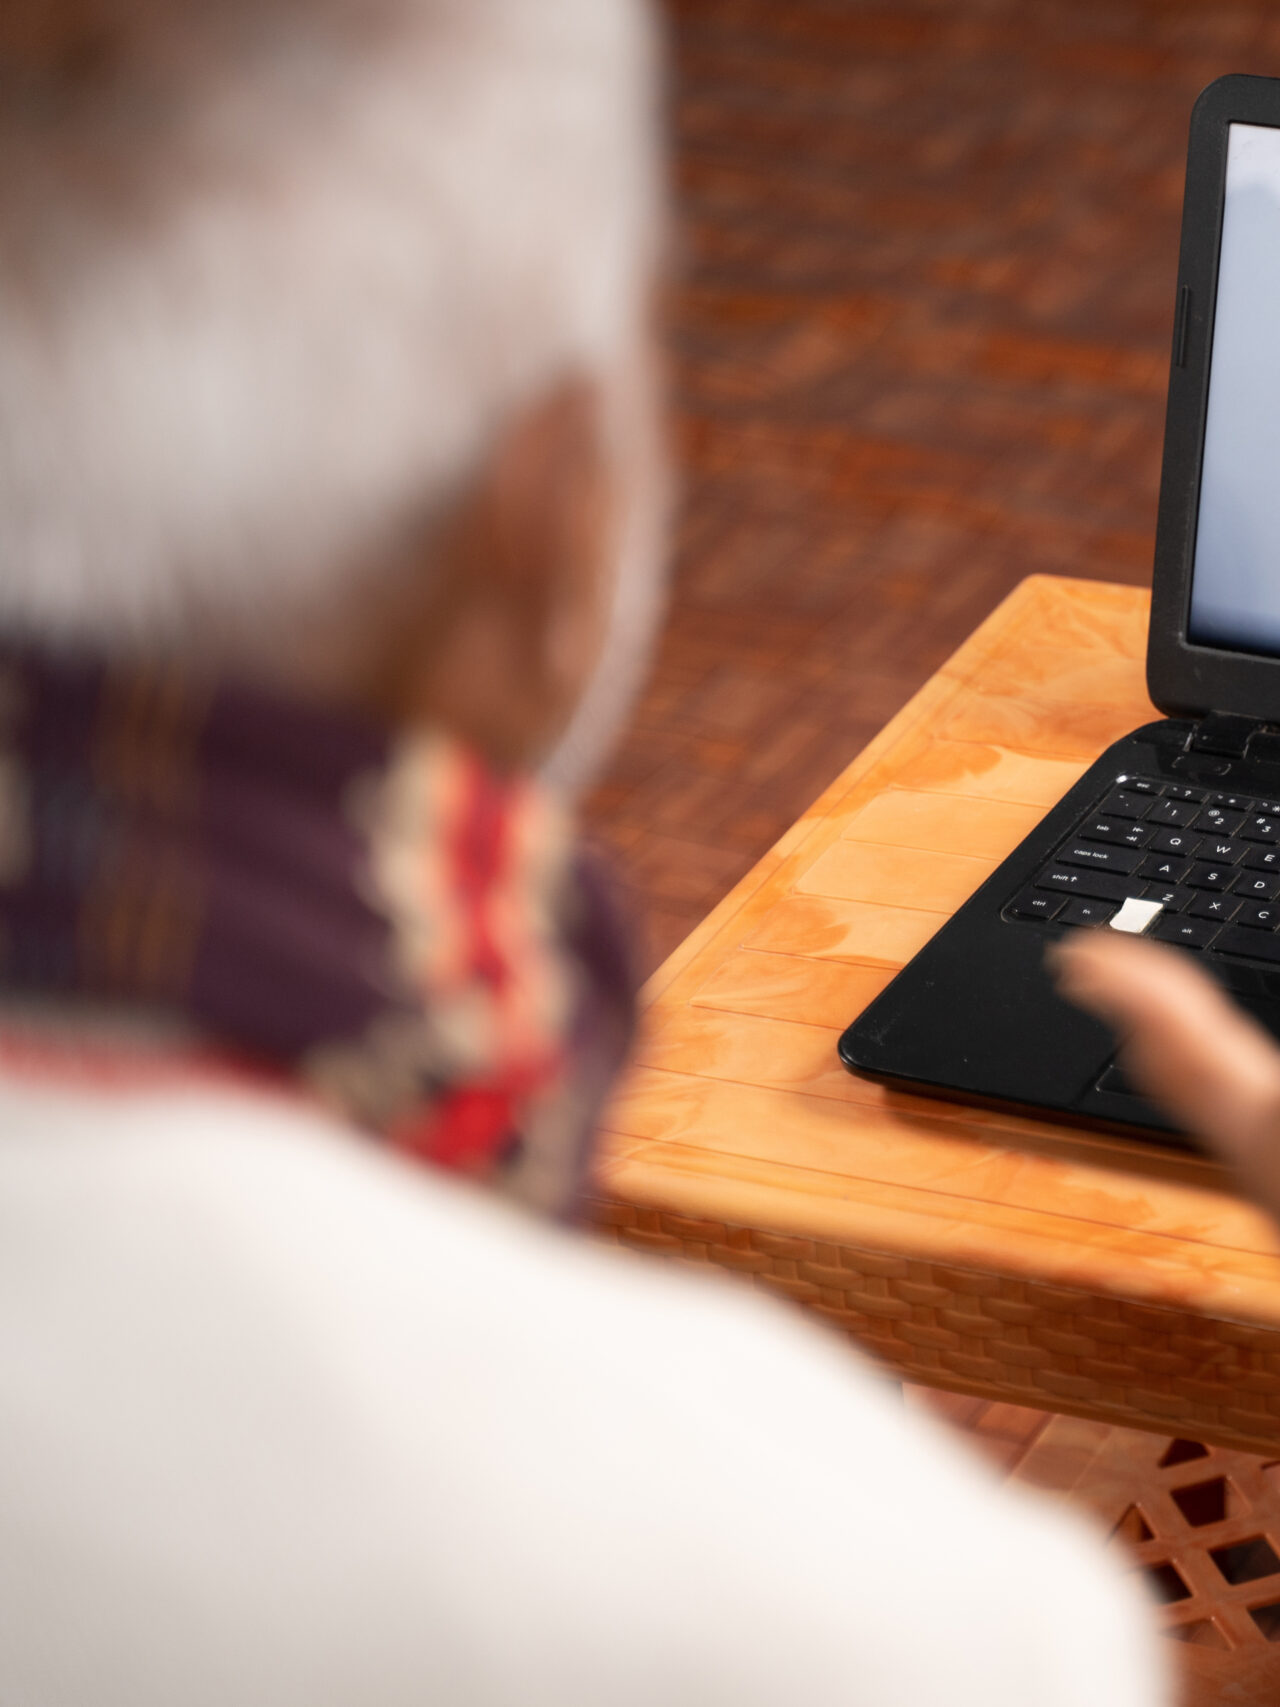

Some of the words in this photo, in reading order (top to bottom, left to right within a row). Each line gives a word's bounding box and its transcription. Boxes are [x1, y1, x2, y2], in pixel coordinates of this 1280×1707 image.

[1208, 809, 1220, 817] @
[1214, 817, 1224, 825] 2
[1262, 825, 1272, 833] 3
[1170, 837, 1182, 846] Q
[1216, 845, 1231, 854] W
[1073, 849, 1091, 857] caps
[1092, 851, 1109, 860] lock
[1264, 854, 1276, 862] E
[1159, 864, 1171, 872] A
[1051, 873, 1069, 881] shift
[1207, 872, 1219, 881] S
[1253, 881, 1266, 889] D
[1162, 893, 1174, 902] Z
[1209, 902, 1221, 910] X
[1258, 911, 1270, 919] C
[1181, 927, 1193, 935] alt
